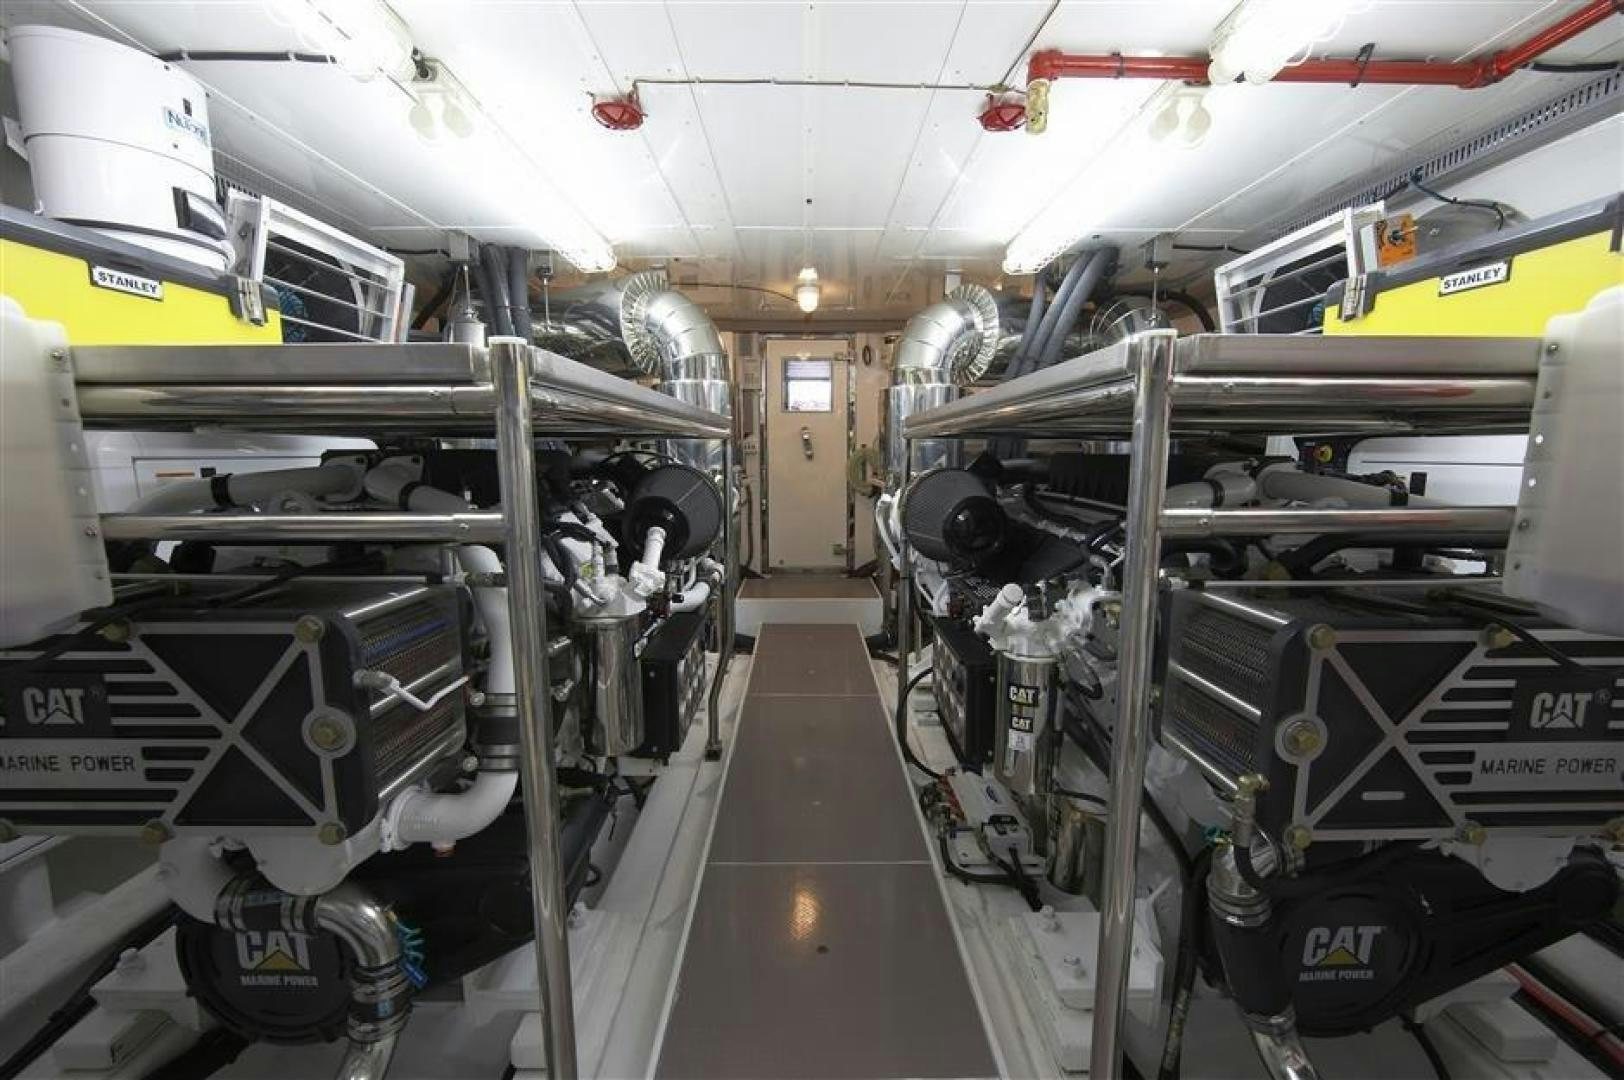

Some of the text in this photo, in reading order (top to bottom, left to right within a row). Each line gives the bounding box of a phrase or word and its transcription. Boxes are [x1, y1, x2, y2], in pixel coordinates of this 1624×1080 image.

[97, 271, 157, 294] STANLEY
[1444, 267, 1502, 289] STANLEY
[1009, 685, 1035, 704] CAT
[23, 687, 84, 724] CAT
[1530, 692, 1593, 728] CAT
[1011, 716, 1031, 730] CAT
[70, 755, 136, 772] POWER
[1481, 758, 1616, 775] MARINE POWER
[235, 930, 312, 970] CAT
[1302, 925, 1387, 966] CAT
[241, 975, 319, 986] MARINE POWER
[1299, 968, 1375, 982] MARINE POWER
